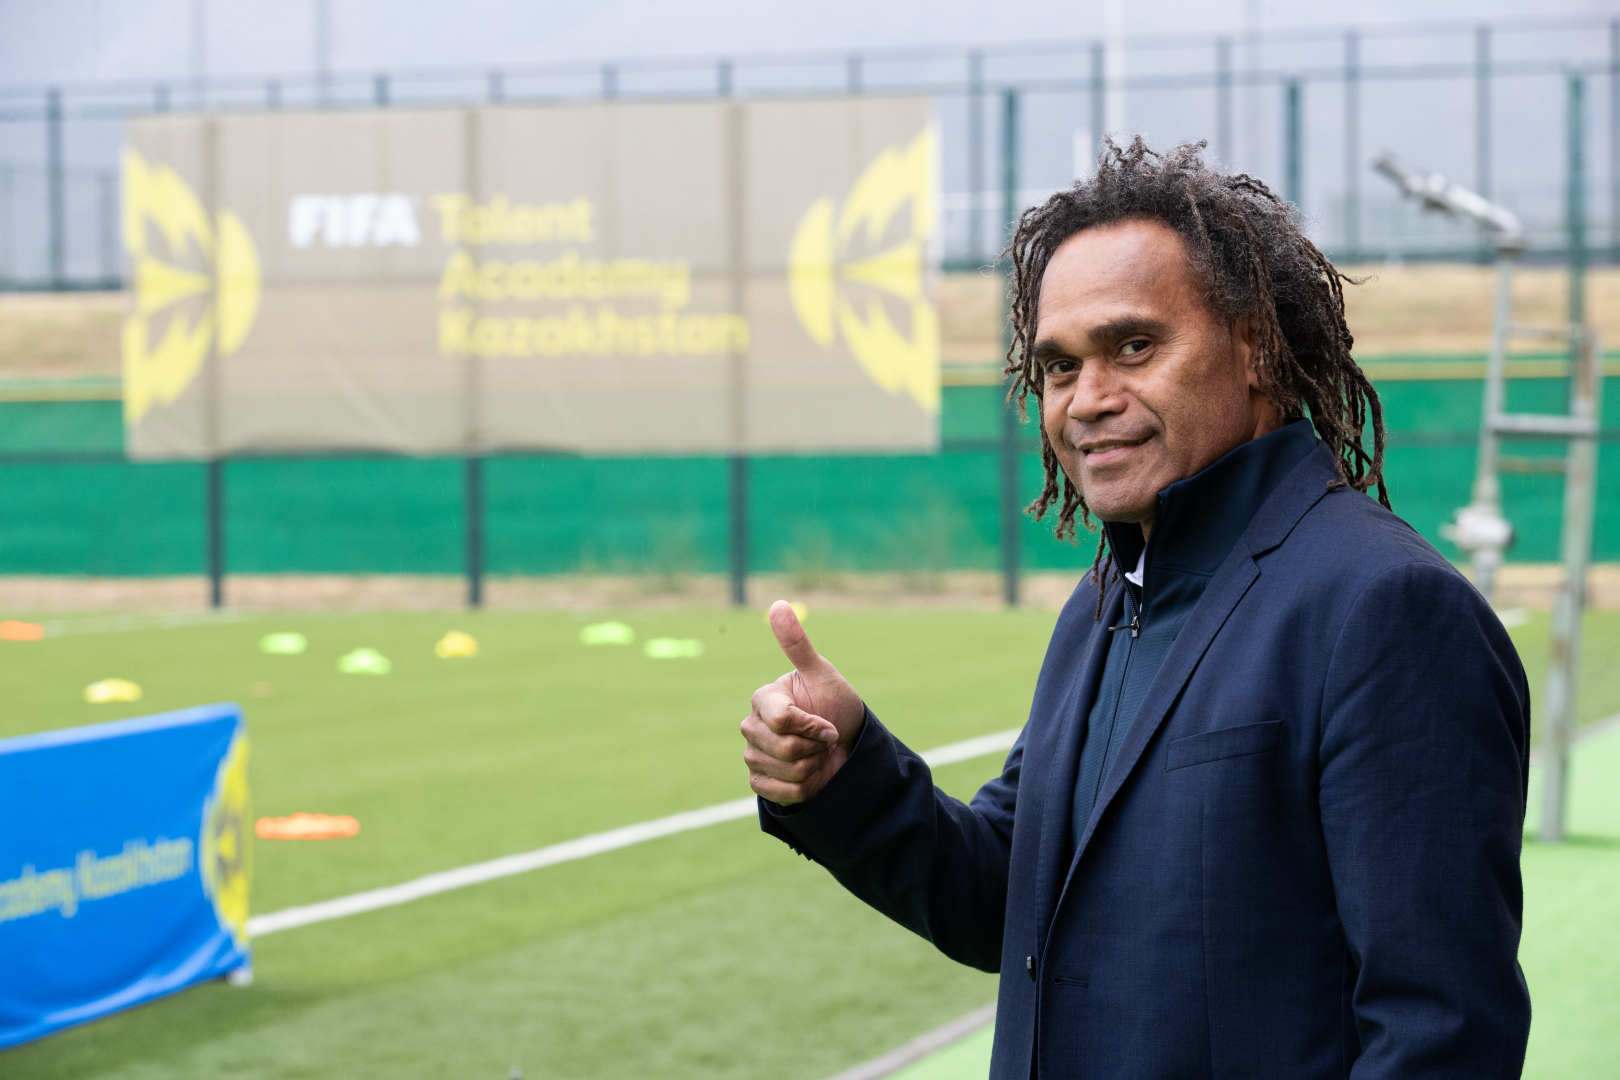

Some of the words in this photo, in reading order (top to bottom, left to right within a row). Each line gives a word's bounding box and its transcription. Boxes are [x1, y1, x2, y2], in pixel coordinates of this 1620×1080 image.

[290, 194, 420, 246] FIFA
[432, 193, 592, 244] Talent
[439, 250, 688, 307] Academy
[438, 308, 747, 356] Kazakhstan
[77, 838, 192, 899] Kazakhstan
